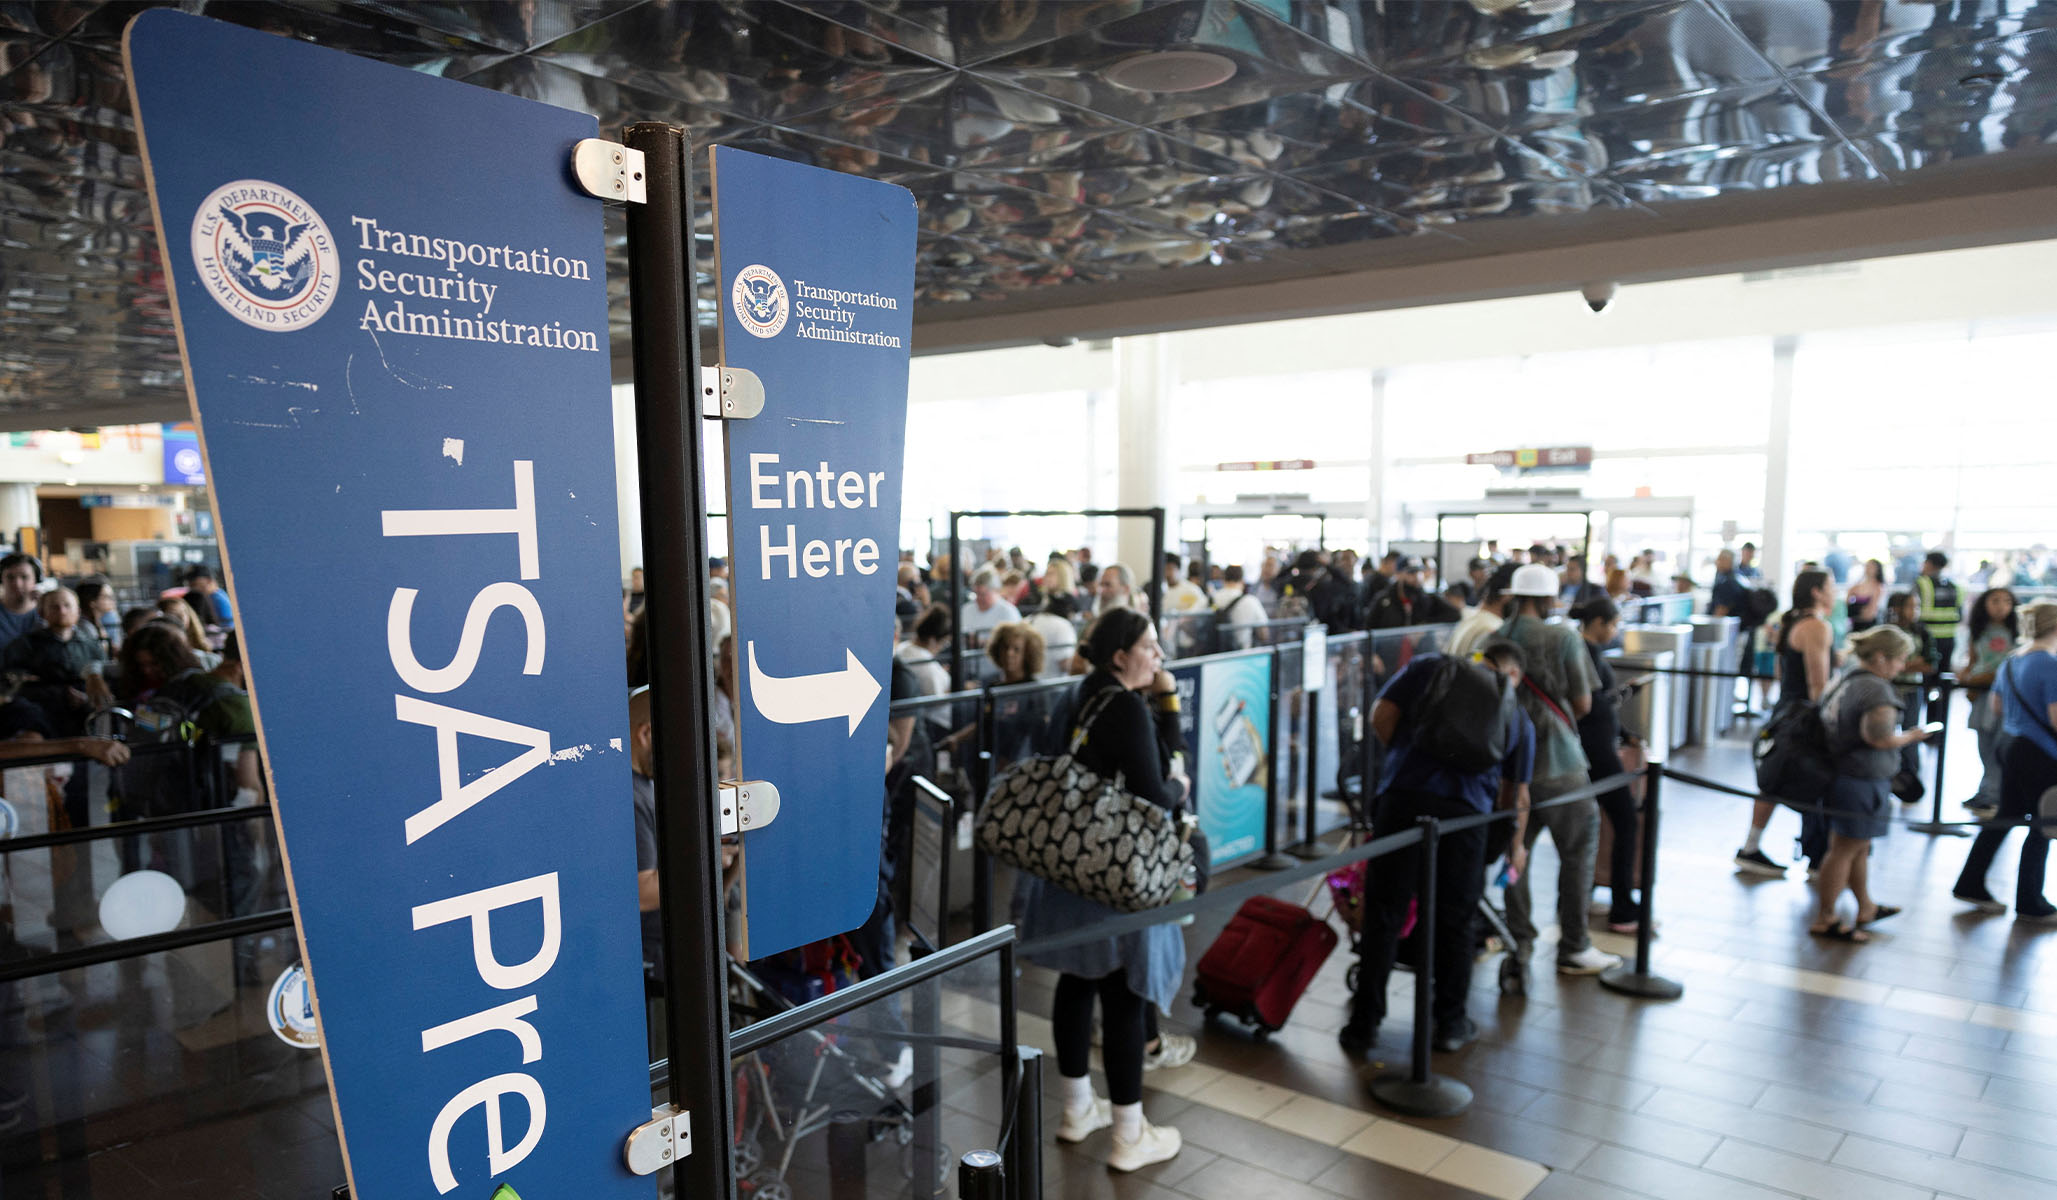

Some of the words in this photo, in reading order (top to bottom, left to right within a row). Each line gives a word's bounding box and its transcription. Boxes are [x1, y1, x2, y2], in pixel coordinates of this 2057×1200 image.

[201, 212, 219, 237] U.S.
[220, 188, 320, 232] DEPARTMENT
[315, 234, 331, 254] OF
[351, 215, 590, 281] Transportation
[203, 256, 276, 323] HOMELAND
[283, 271, 332, 324] SECURITY
[357, 258, 497, 314] Security
[794, 279, 898, 310] Transportation
[360, 299, 599, 352] Administration
[766, 308, 786, 334] SECURITY
[796, 301, 856, 328] Security
[796, 321, 901, 348] Administration
[750, 453, 885, 509] Enter
[760, 524, 880, 580] Here
[381, 459, 552, 846] TSA
[411, 871, 562, 1196] Pre
